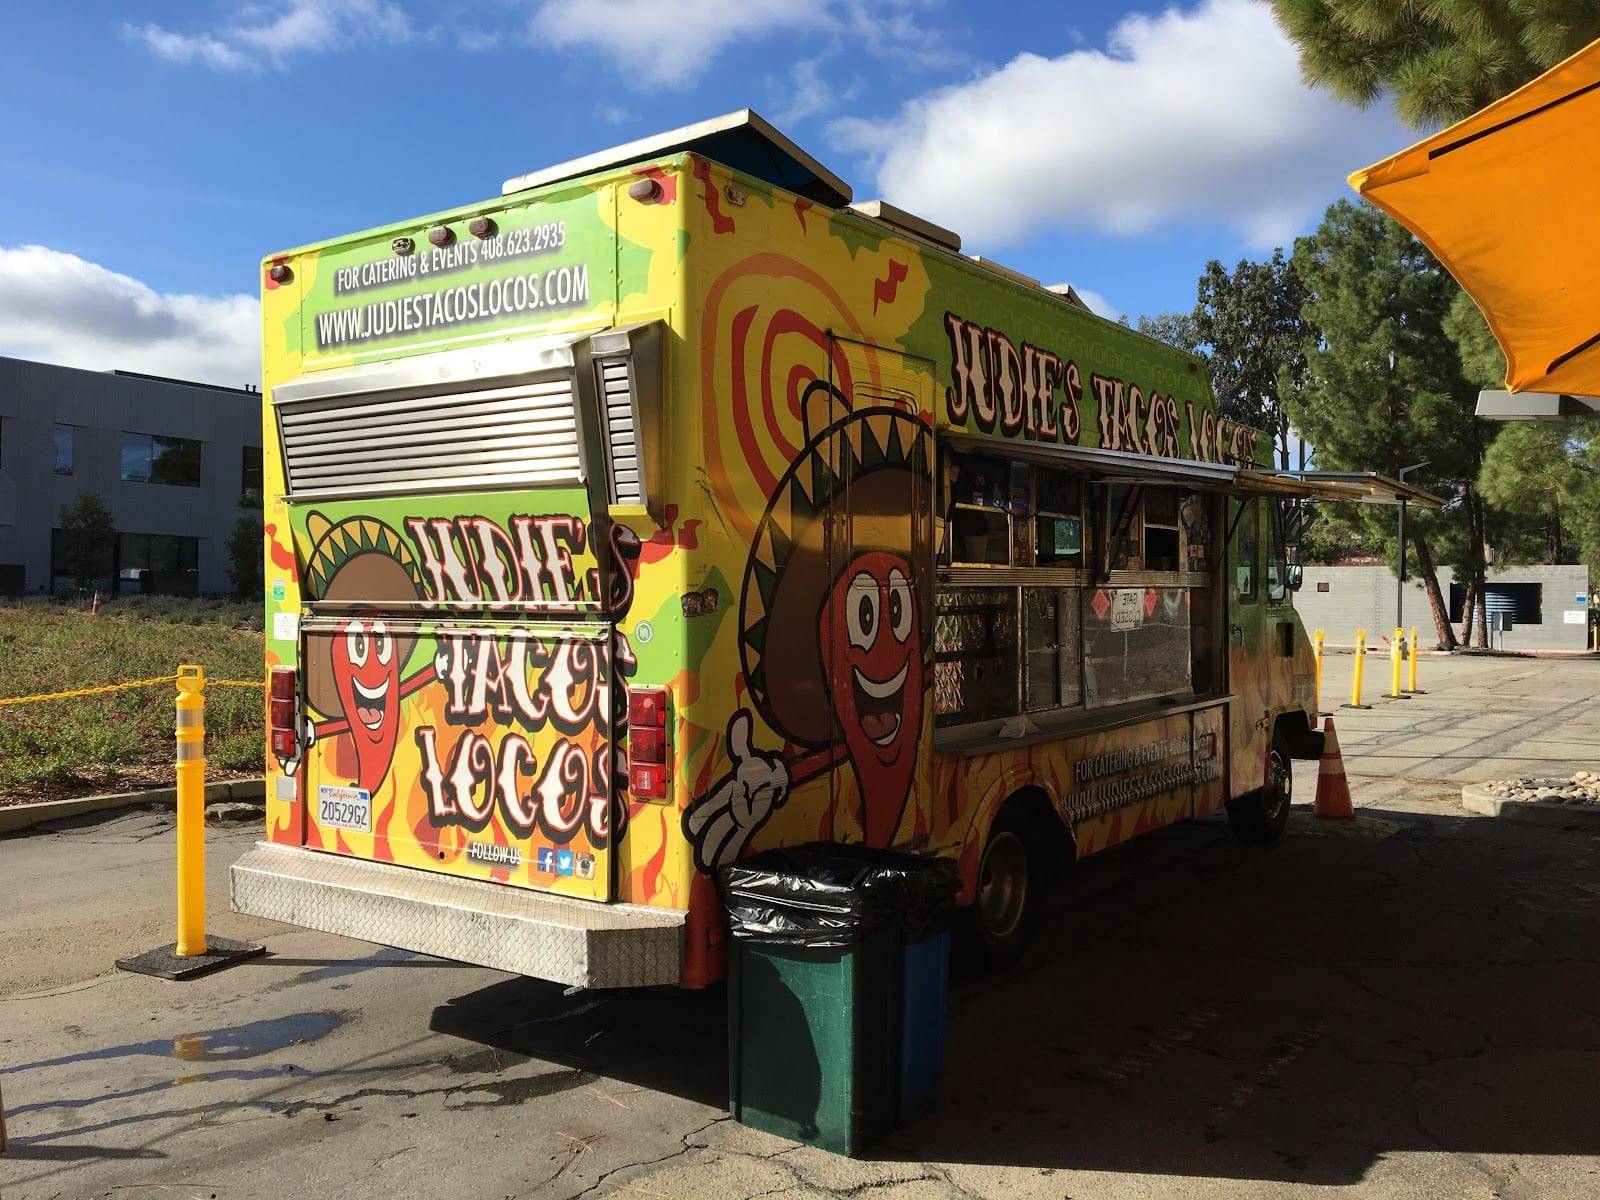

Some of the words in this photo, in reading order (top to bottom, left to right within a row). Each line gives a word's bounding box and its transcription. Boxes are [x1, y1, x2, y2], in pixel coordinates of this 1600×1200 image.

[337, 269, 360, 292] FOR
[362, 253, 417, 283] CATERING
[420, 252, 429, 274] &
[432, 240, 478, 272] EVENTS
[480, 221, 567, 260] 408.623.2935
[318, 264, 590, 345] WWW.JUDIESTACOSLOCOS.COM
[945, 312, 1082, 443] JUDIE'S
[1091, 373, 1180, 459] TACOS
[1075, 757, 1094, 783] FOR
[1094, 748, 1134, 778] CATERING
[1134, 747, 1142, 767] &
[1142, 738, 1168, 763] EVENTS
[321, 800, 367, 826] 20529G2
[471, 841, 509, 863] FOLLOW
[510, 848, 522, 865] US
